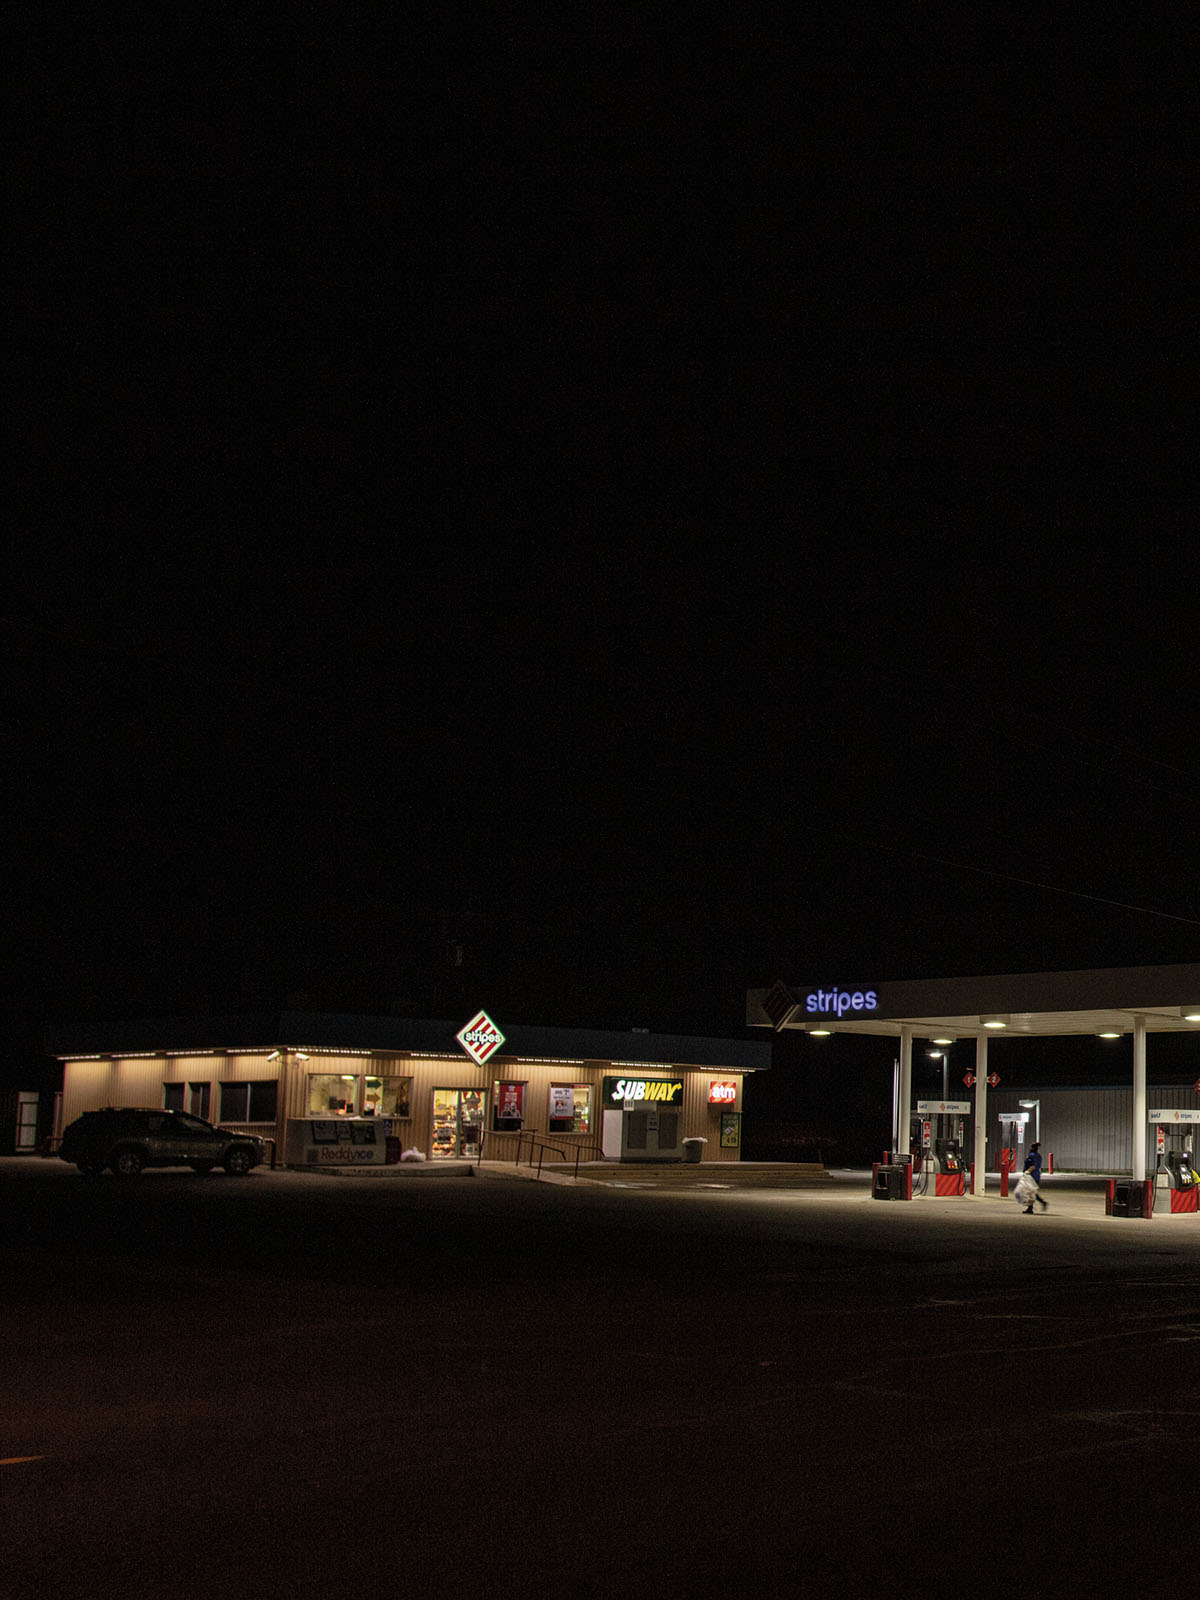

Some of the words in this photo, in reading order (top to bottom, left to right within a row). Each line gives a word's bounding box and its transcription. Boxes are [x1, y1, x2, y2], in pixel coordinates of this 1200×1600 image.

[805, 986, 878, 1017] stripes
[464, 1029, 502, 1046] stripes
[966, 1076, 971, 1084] 1
[991, 1076, 997, 1084] 2
[611, 1079, 682, 1102] SUBWAY
[711, 1085, 737, 1099] atm
